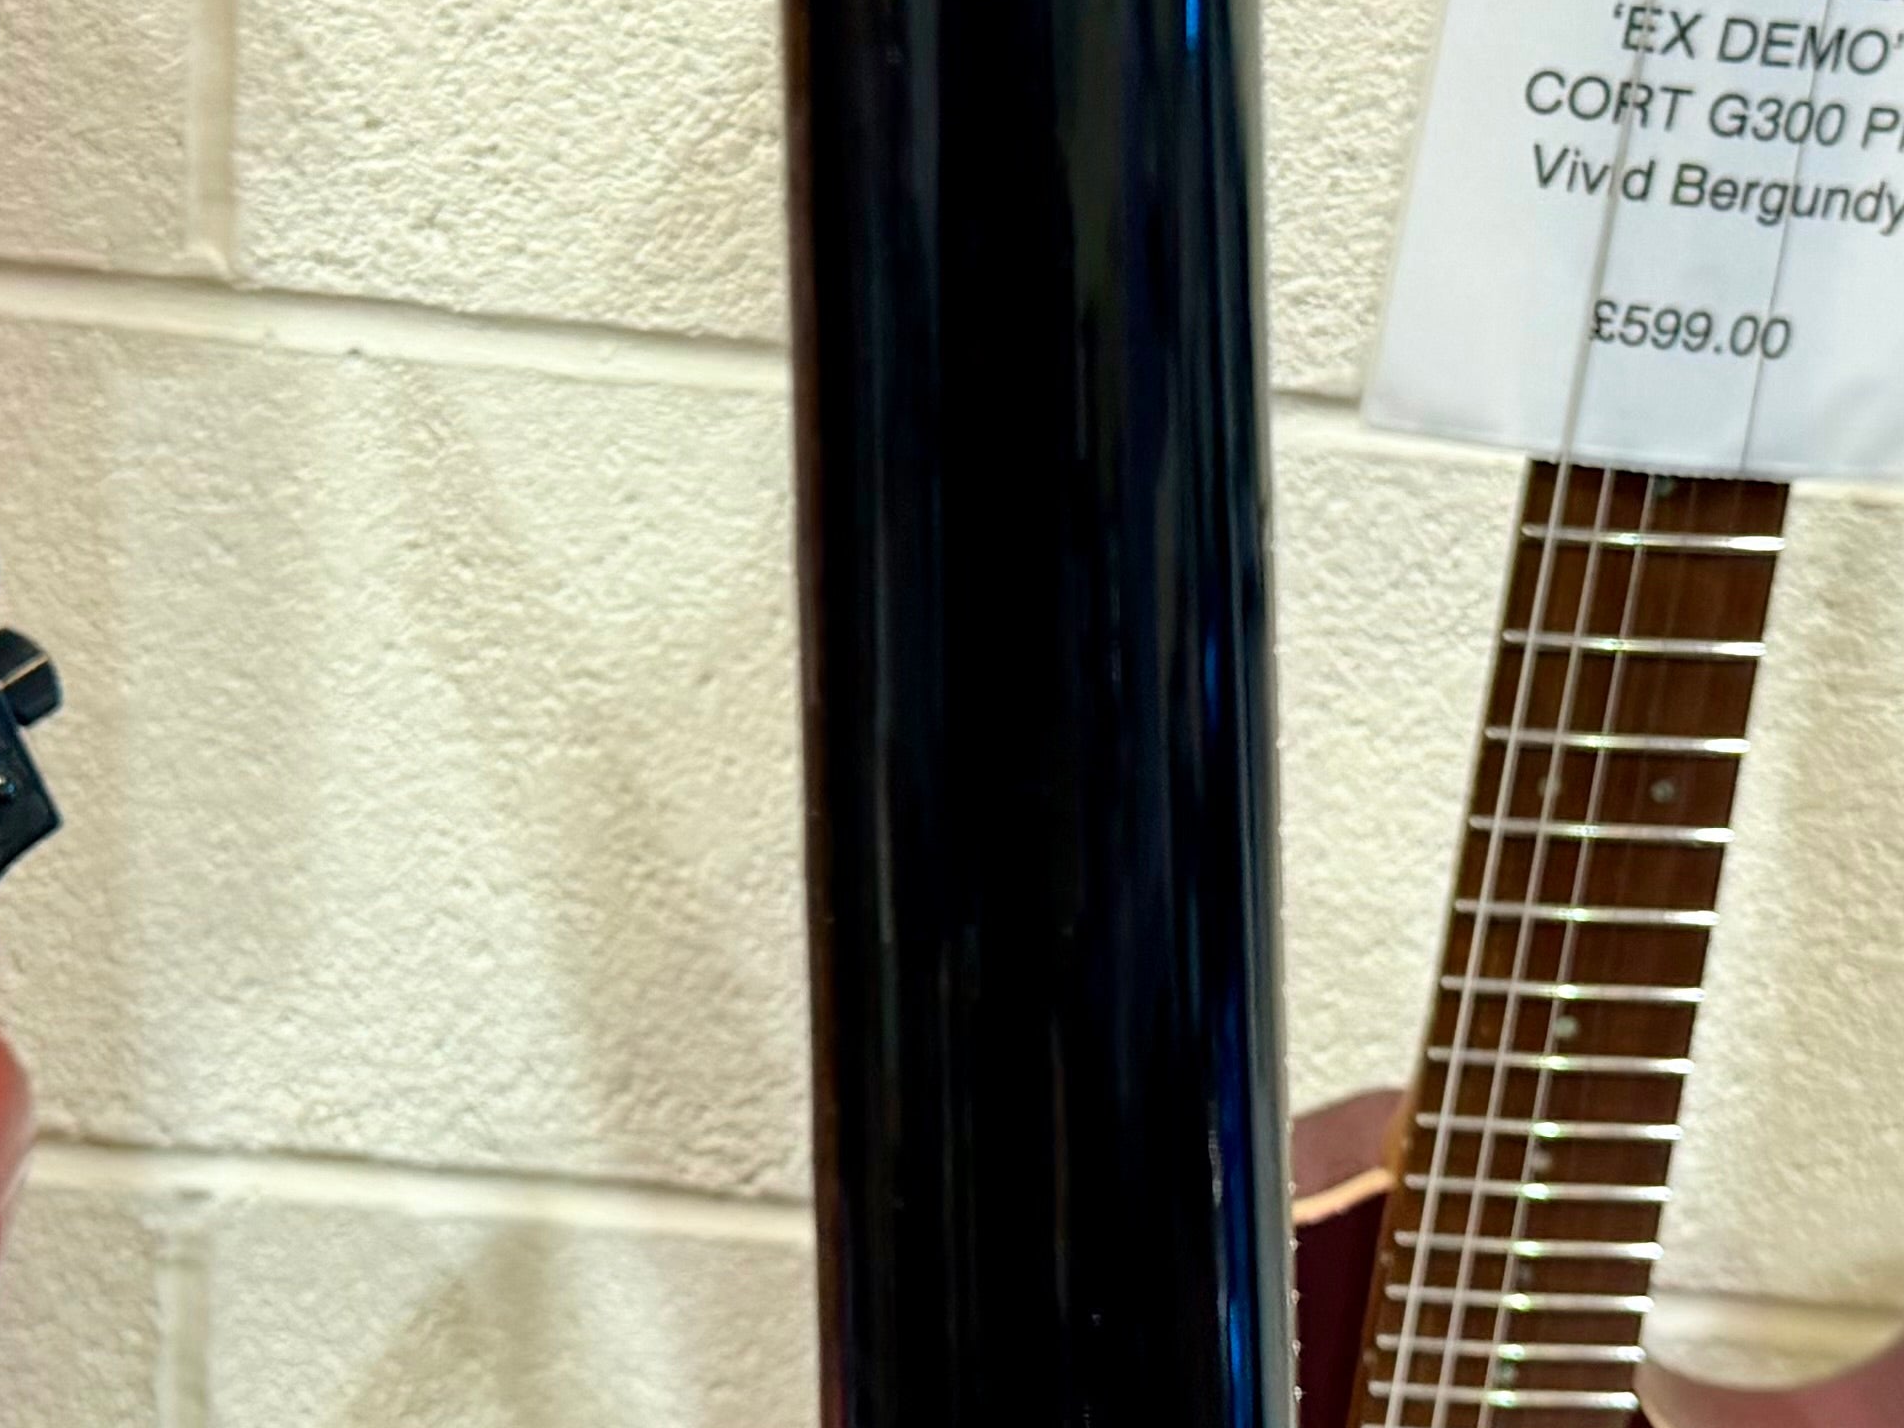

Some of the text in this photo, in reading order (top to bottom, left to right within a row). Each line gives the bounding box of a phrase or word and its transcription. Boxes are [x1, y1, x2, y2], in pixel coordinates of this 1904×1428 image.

[1525, 71, 1692, 128] CORT
[1709, 92, 1846, 145] G300
[1532, 143, 1655, 203] Vivd
[1591, 300, 1792, 361] £599.00
